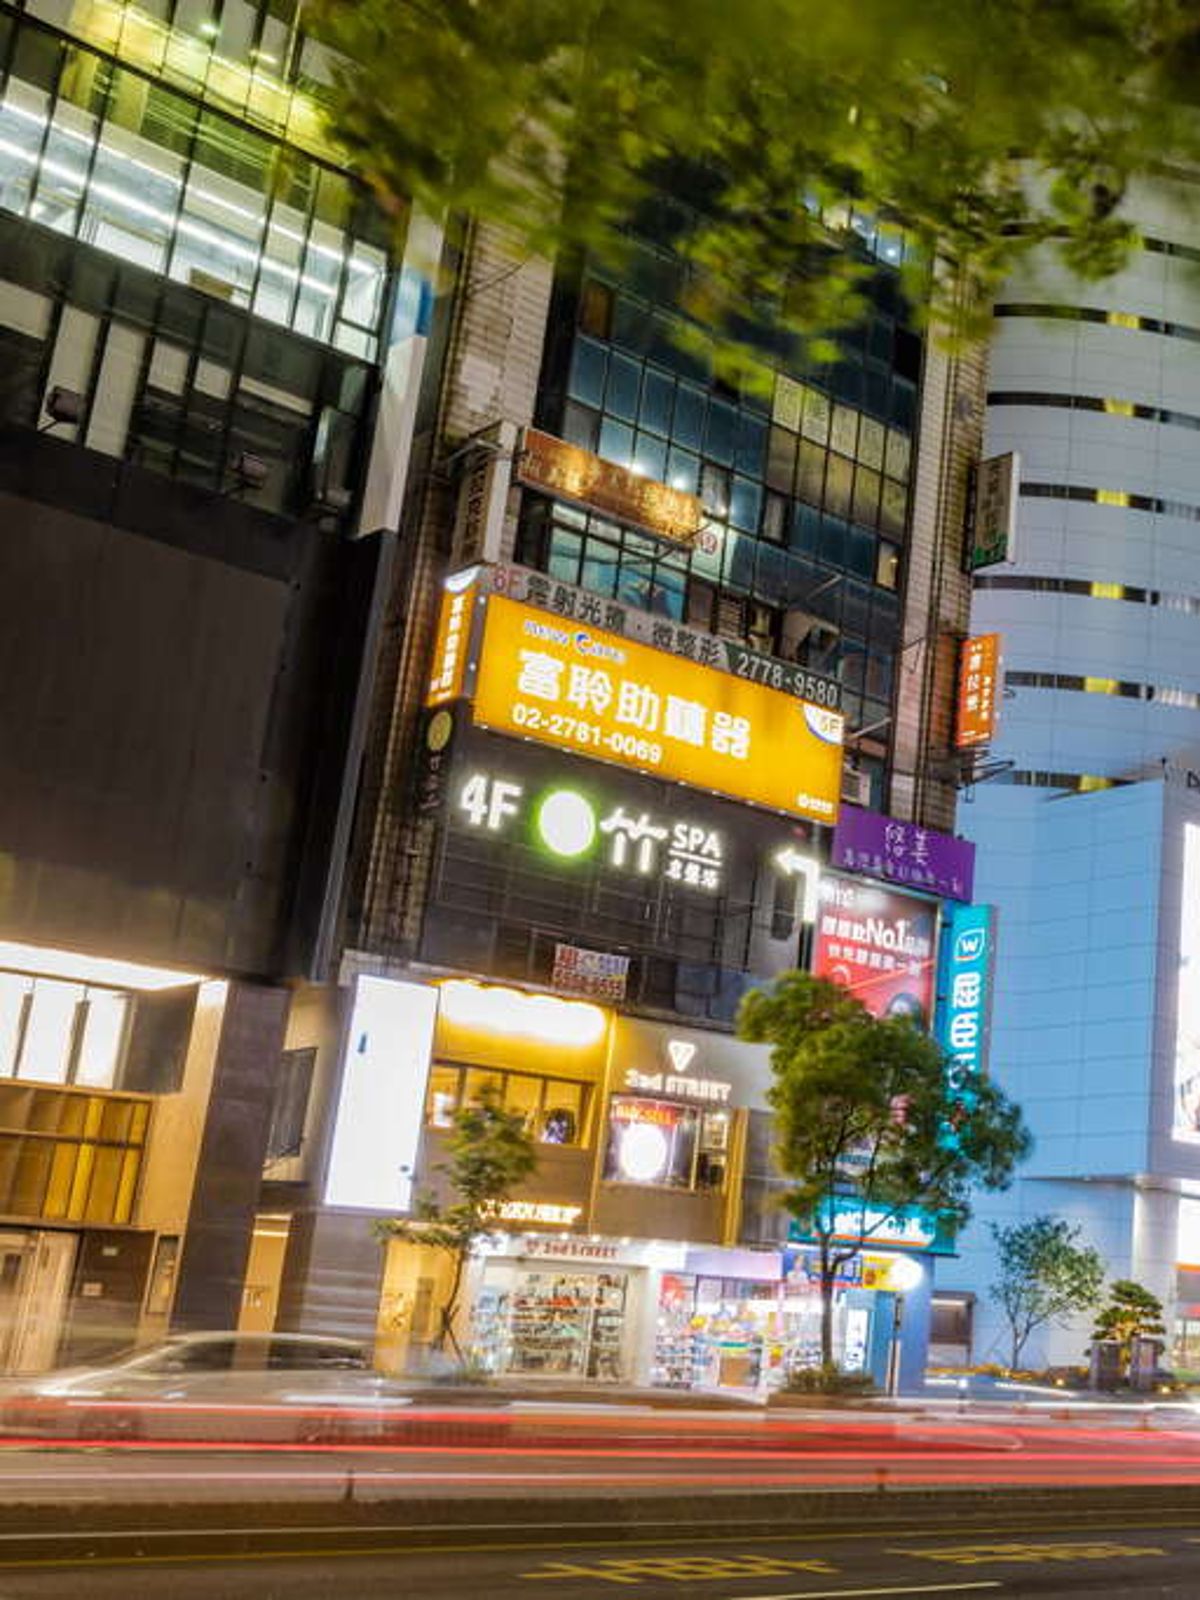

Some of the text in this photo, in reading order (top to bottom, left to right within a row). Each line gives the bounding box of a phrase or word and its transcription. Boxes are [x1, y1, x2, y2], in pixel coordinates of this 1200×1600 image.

[736, 651, 840, 706] 2778-9580
[460, 773, 523, 830] 4F
[672, 823, 722, 859] SPA
